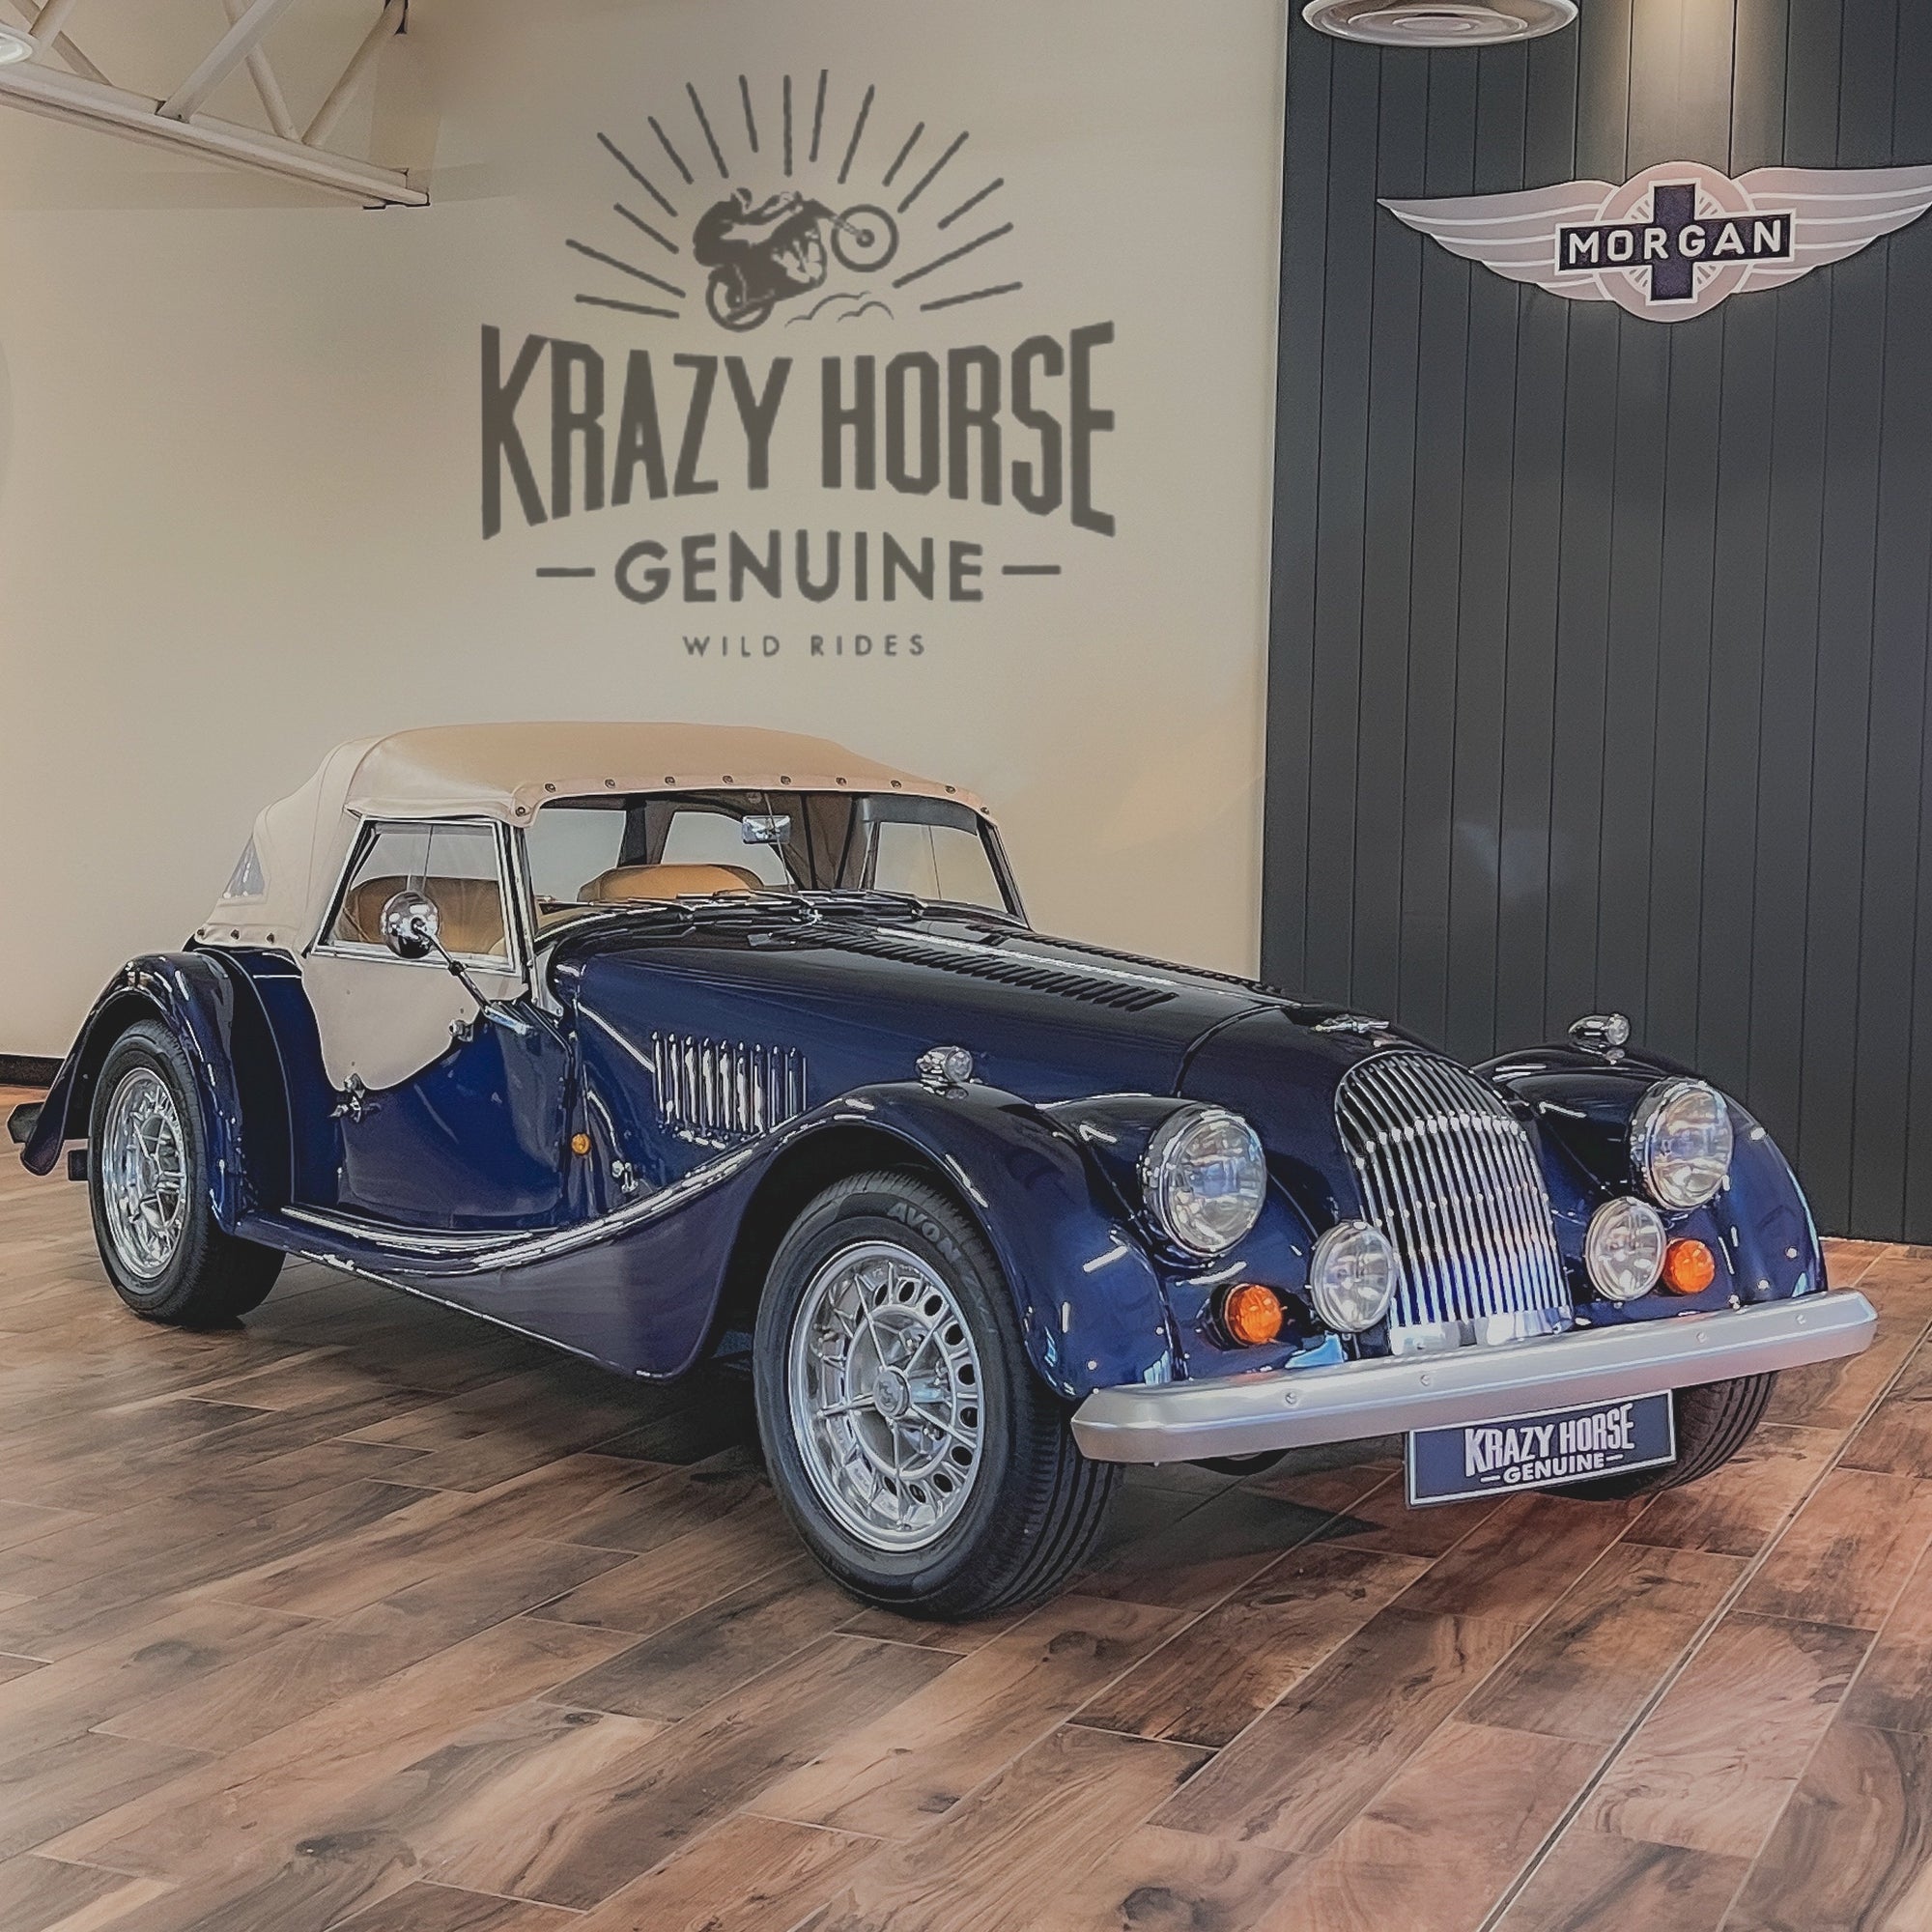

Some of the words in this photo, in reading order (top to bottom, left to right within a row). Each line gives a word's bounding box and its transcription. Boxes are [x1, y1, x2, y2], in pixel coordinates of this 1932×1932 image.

[1569, 220, 1781, 264] MORGAN
[481, 324, 793, 540] KRAZY
[821, 320, 1116, 537] HORSE
[614, 529, 983, 604] GENUINE
[682, 635, 781, 658] WILD
[810, 634, 924, 657] RIDES
[887, 1202, 961, 1262] AVON
[1464, 1425, 1554, 1477] KRAZY
[1559, 1403, 1635, 1453] HORSE
[1503, 1453, 1605, 1484] GENUINE
